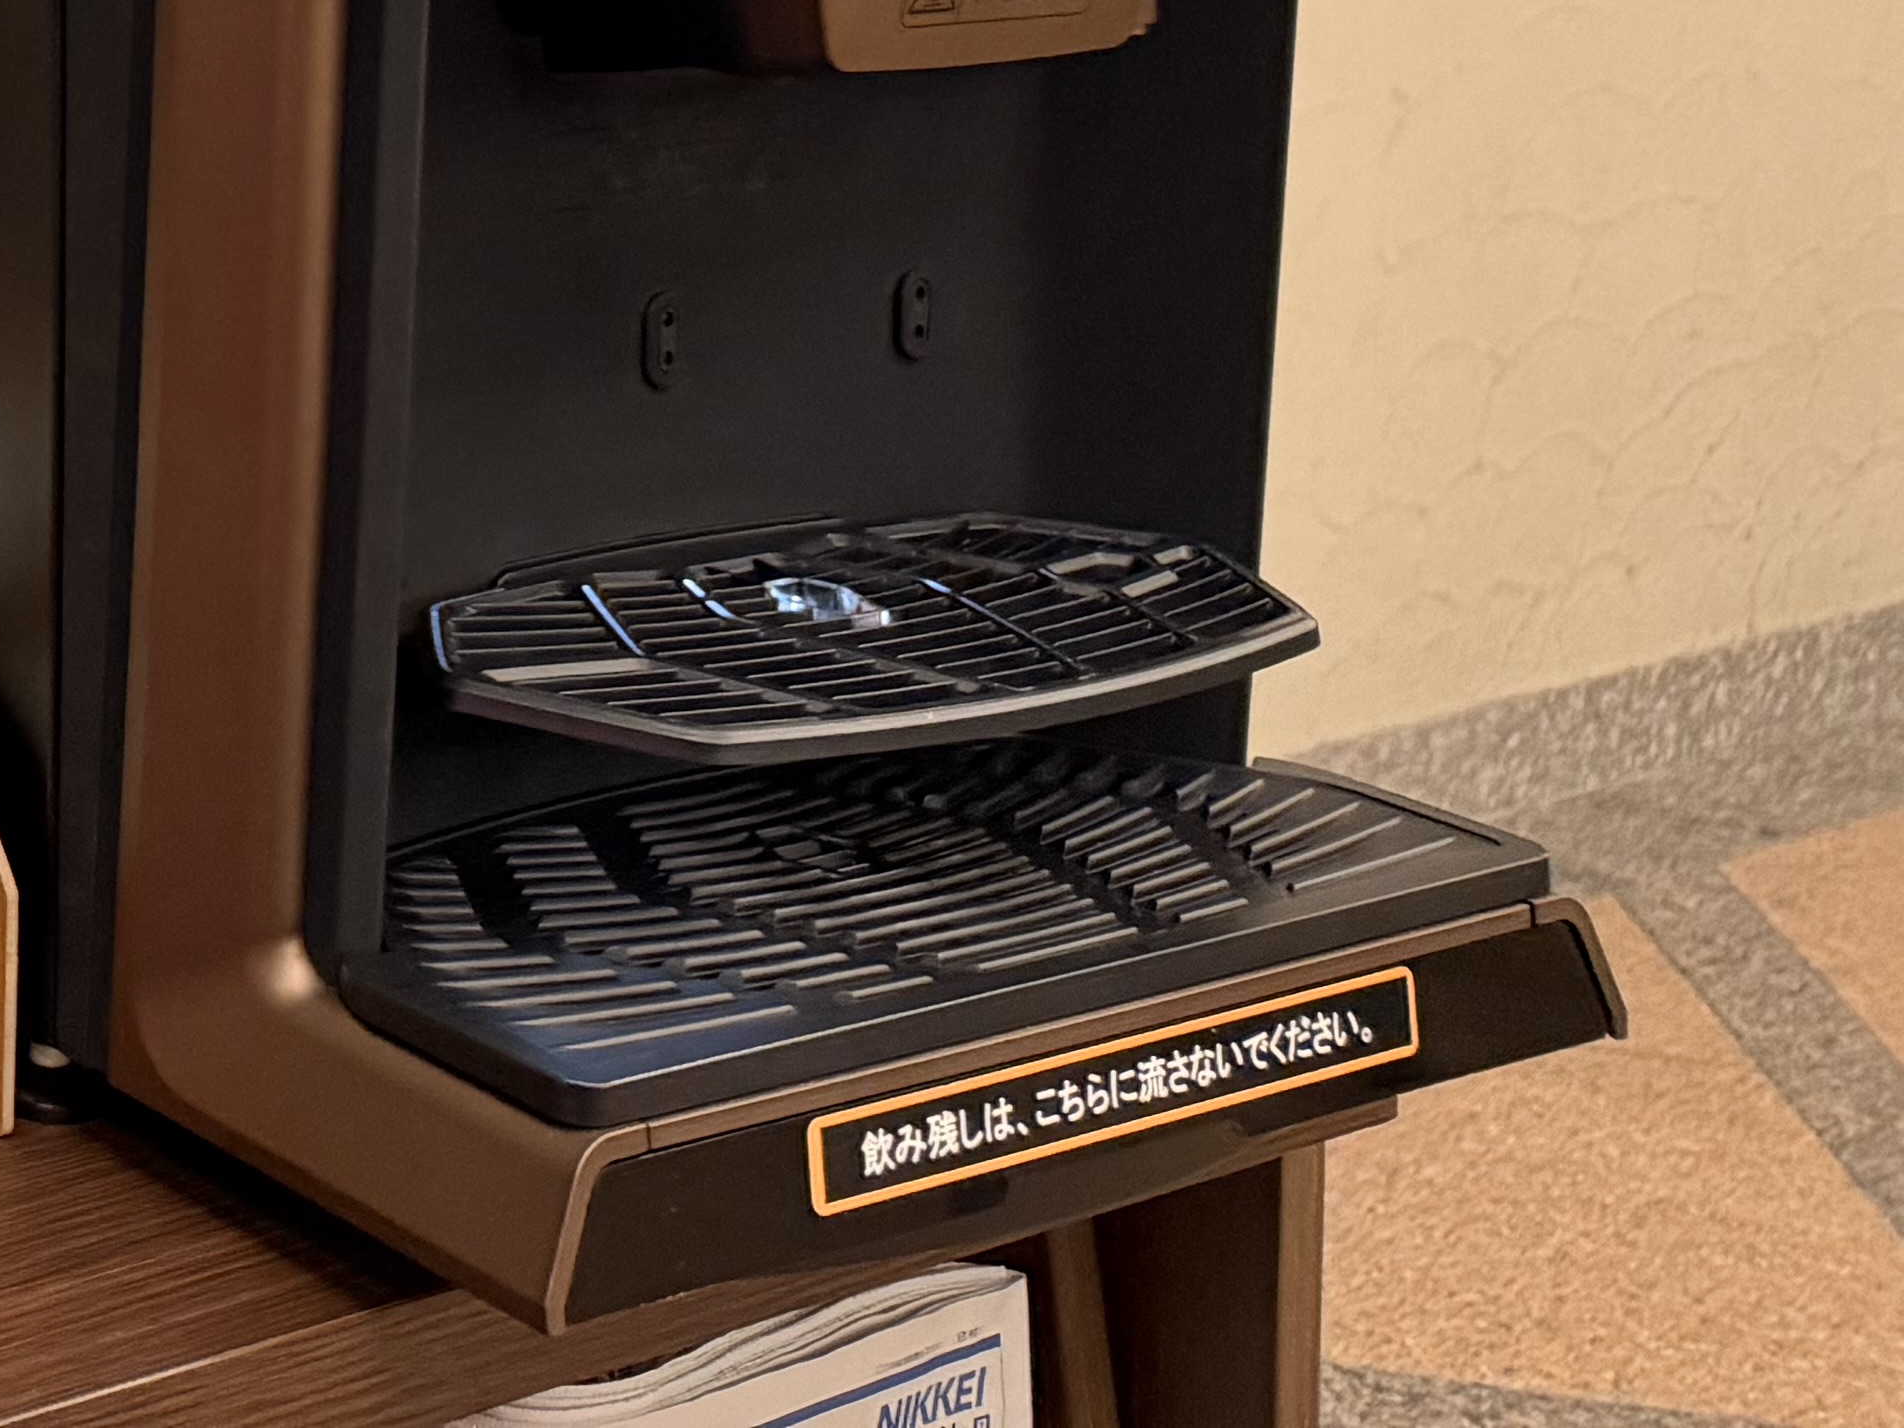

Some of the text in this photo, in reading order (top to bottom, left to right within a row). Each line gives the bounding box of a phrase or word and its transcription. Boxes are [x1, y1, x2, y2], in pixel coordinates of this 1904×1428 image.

[860, 1009, 1374, 1178] 飲み残しは、こちらに流さないでください。
[877, 1366, 987, 1428] NIKKEI
